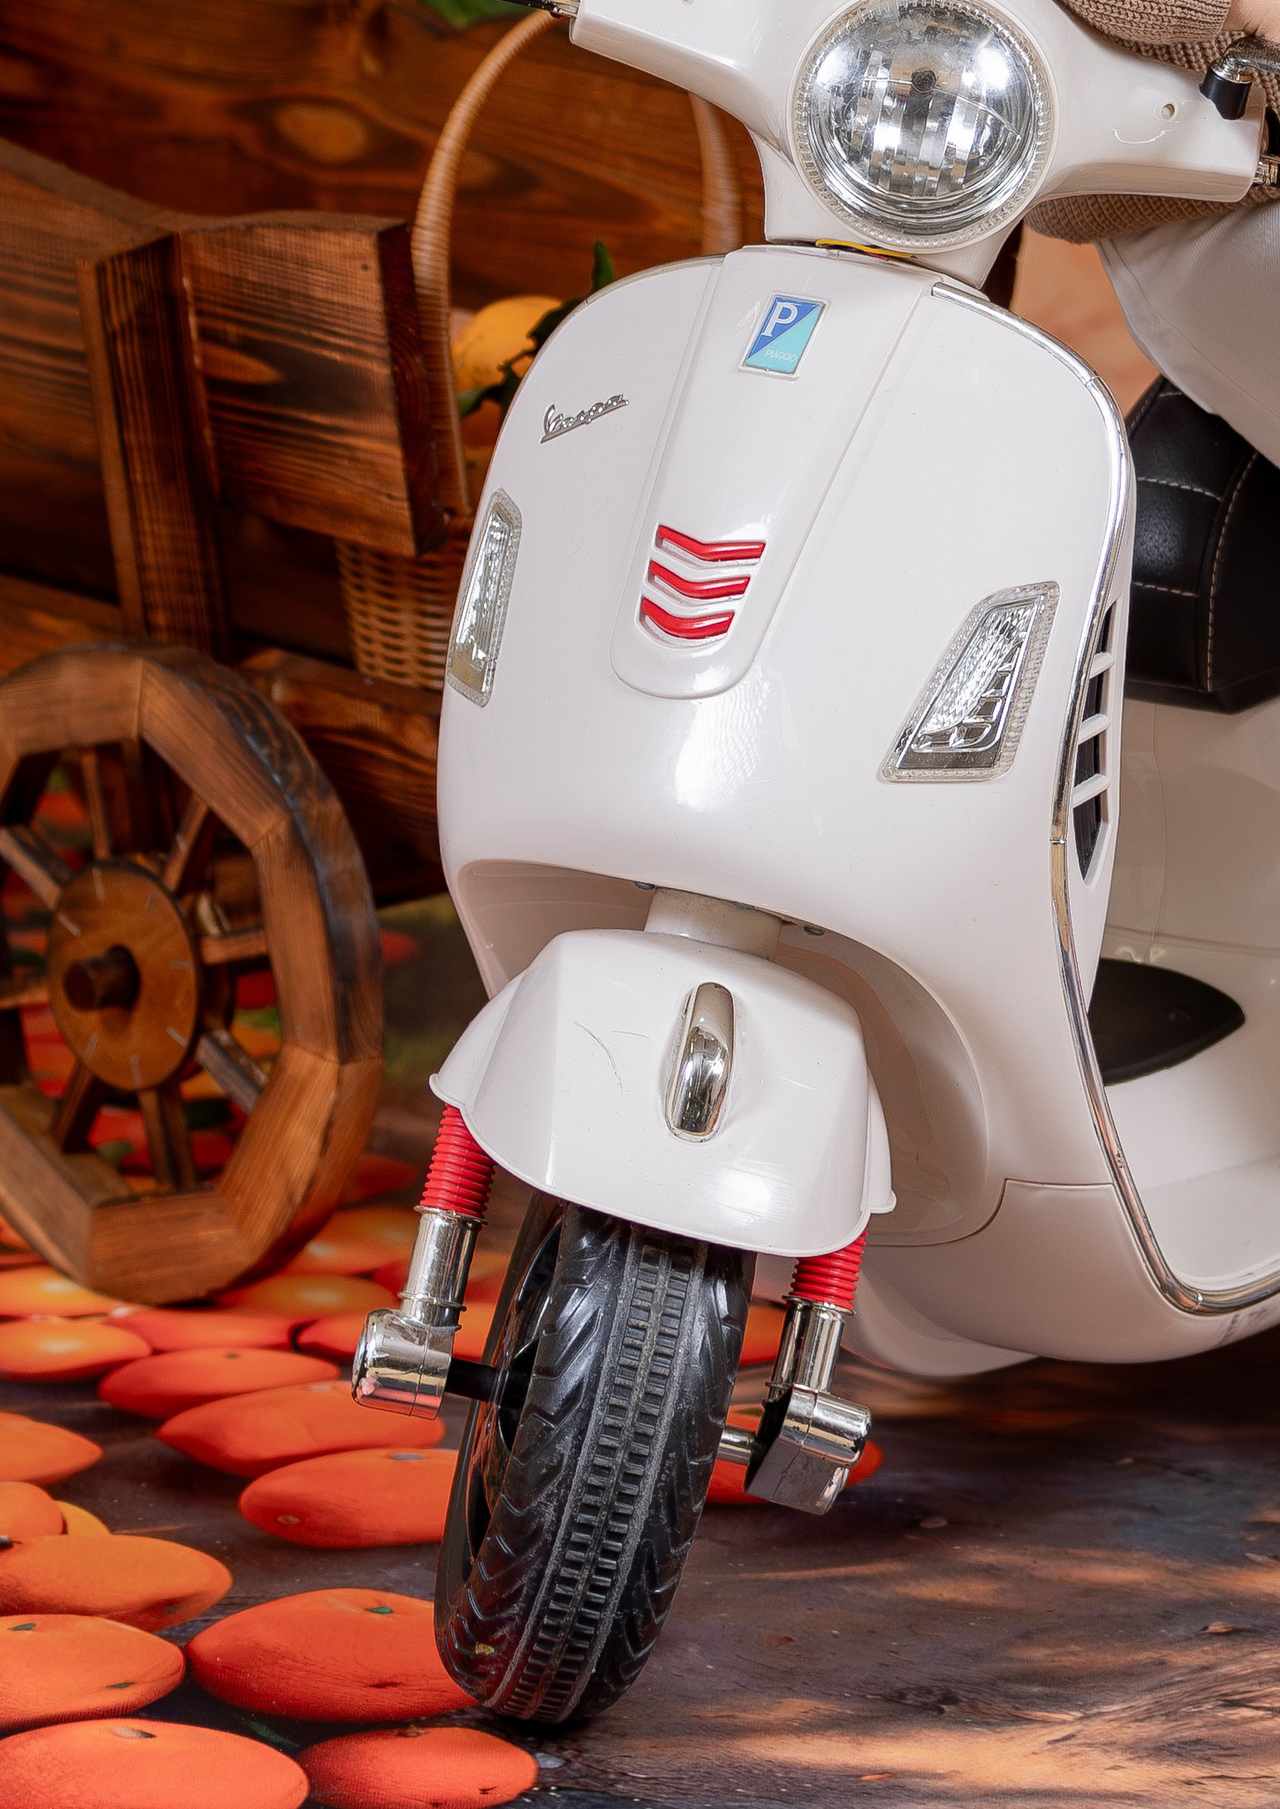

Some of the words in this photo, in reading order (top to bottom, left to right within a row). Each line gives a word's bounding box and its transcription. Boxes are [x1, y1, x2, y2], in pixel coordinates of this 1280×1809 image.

[760, 301, 799, 338] P
[765, 349, 798, 362] PIAGGIO
[539, 394, 629, 443] Vespa
